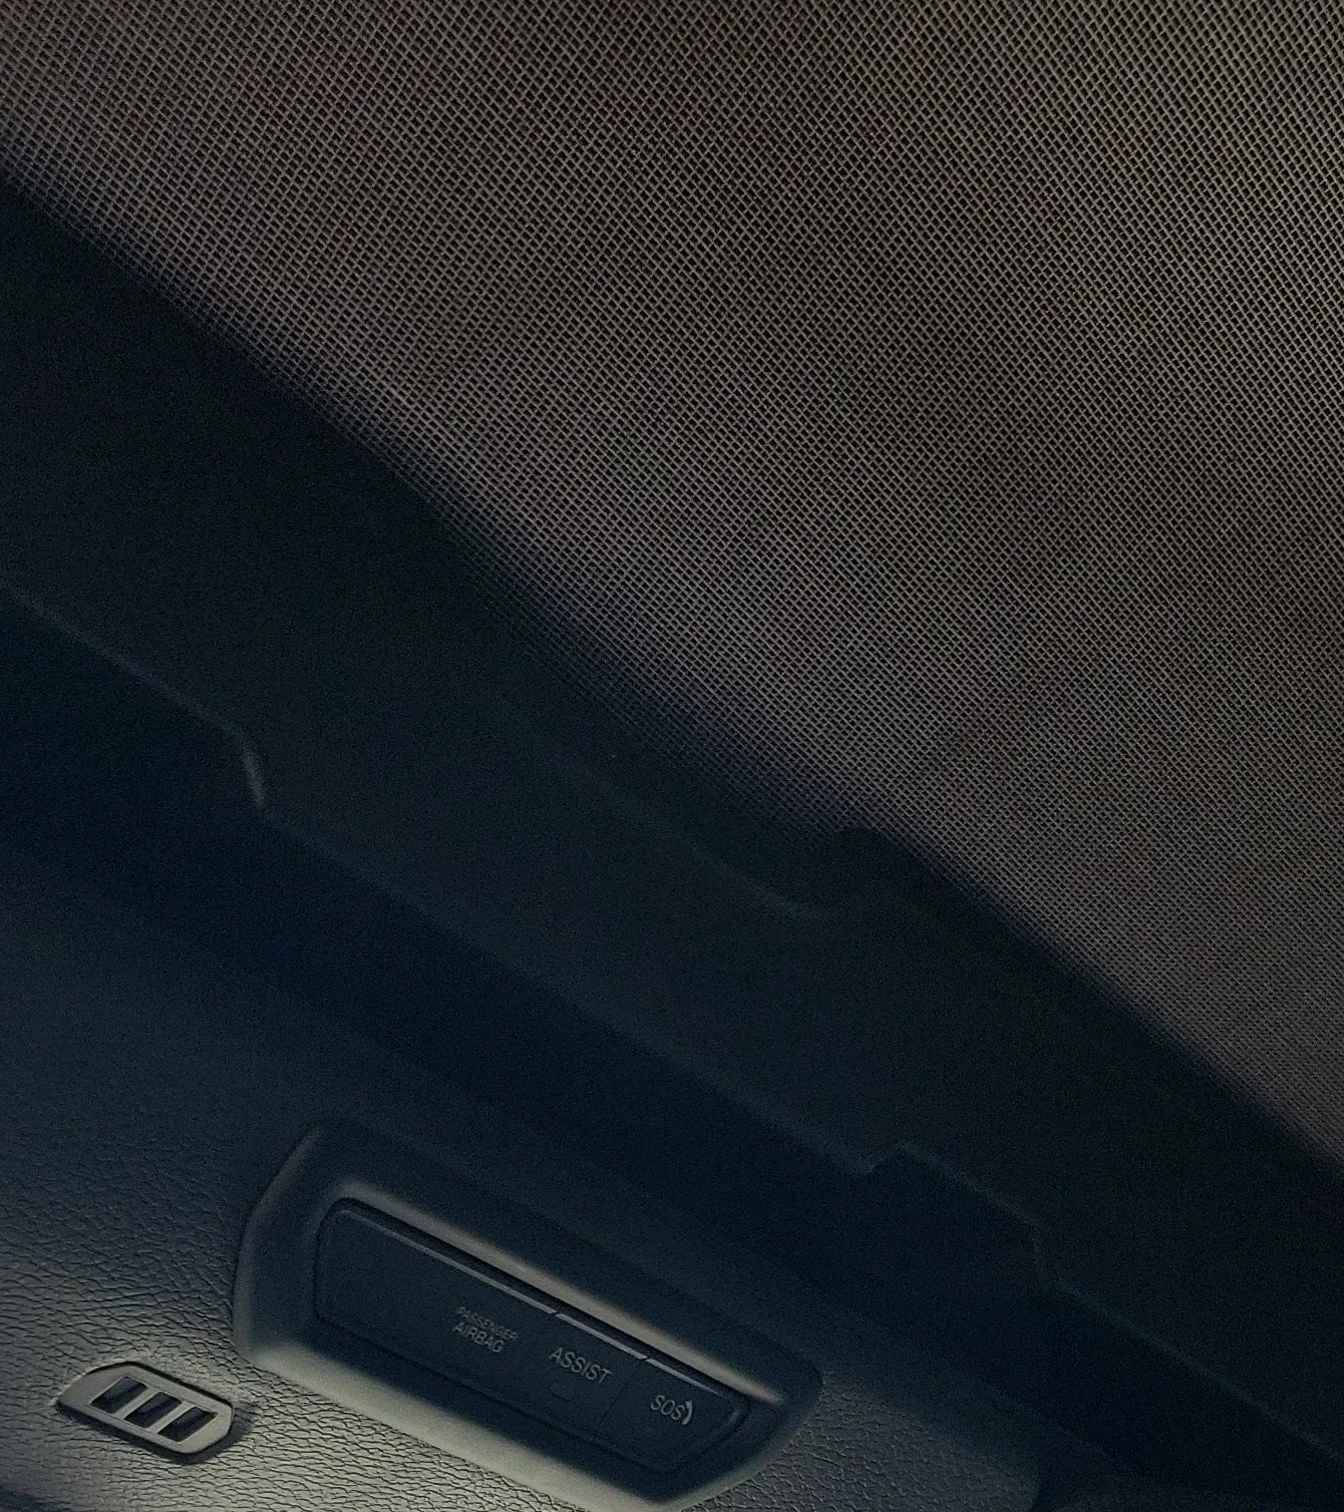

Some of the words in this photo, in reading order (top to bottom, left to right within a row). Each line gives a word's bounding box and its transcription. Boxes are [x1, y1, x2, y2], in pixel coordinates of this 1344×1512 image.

[453, 1321, 505, 1353] AIRBAG
[457, 1306, 517, 1341] PASSENGER
[549, 1347, 612, 1384] ASSIST
[650, 1395, 687, 1422] SOS
